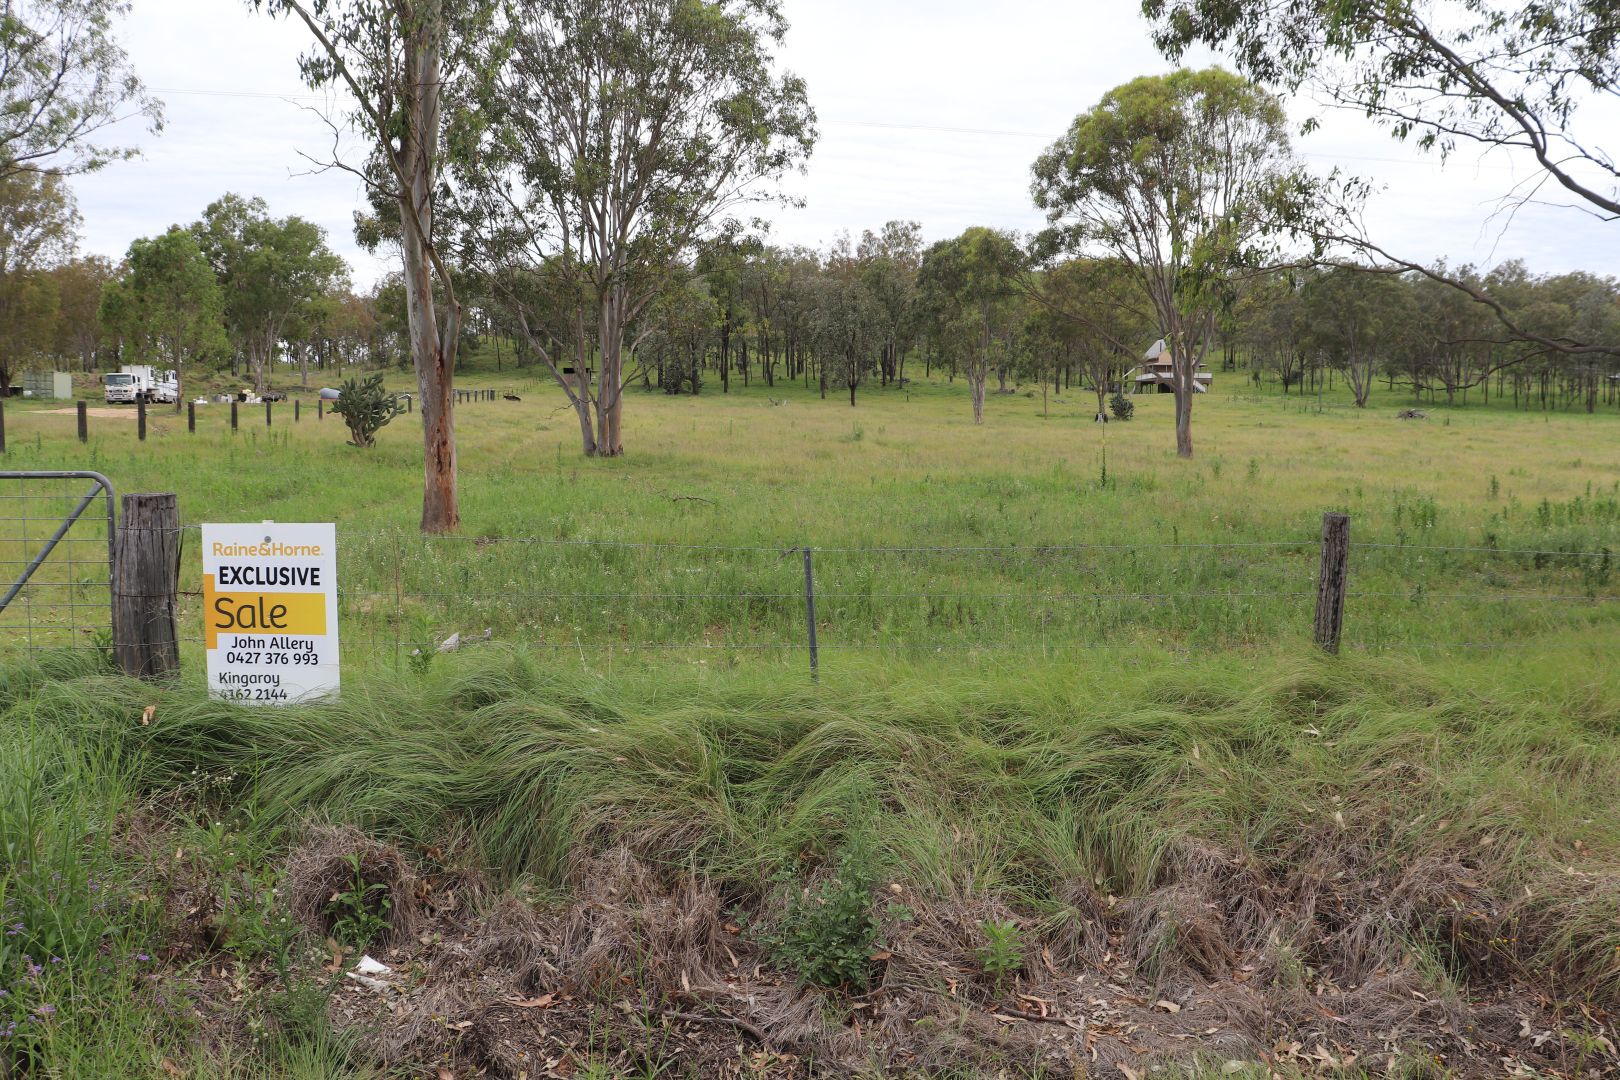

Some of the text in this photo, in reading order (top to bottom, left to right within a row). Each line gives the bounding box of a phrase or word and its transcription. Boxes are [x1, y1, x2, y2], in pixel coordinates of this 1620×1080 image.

[219, 566, 321, 586] EXCLUSIVE
[214, 596, 288, 629] Sale
[231, 636, 314, 654] John Allery
[226, 652, 319, 666] 0427 376 993
[219, 672, 280, 688] Kingaroy
[219, 688, 287, 701] 4162 2144
